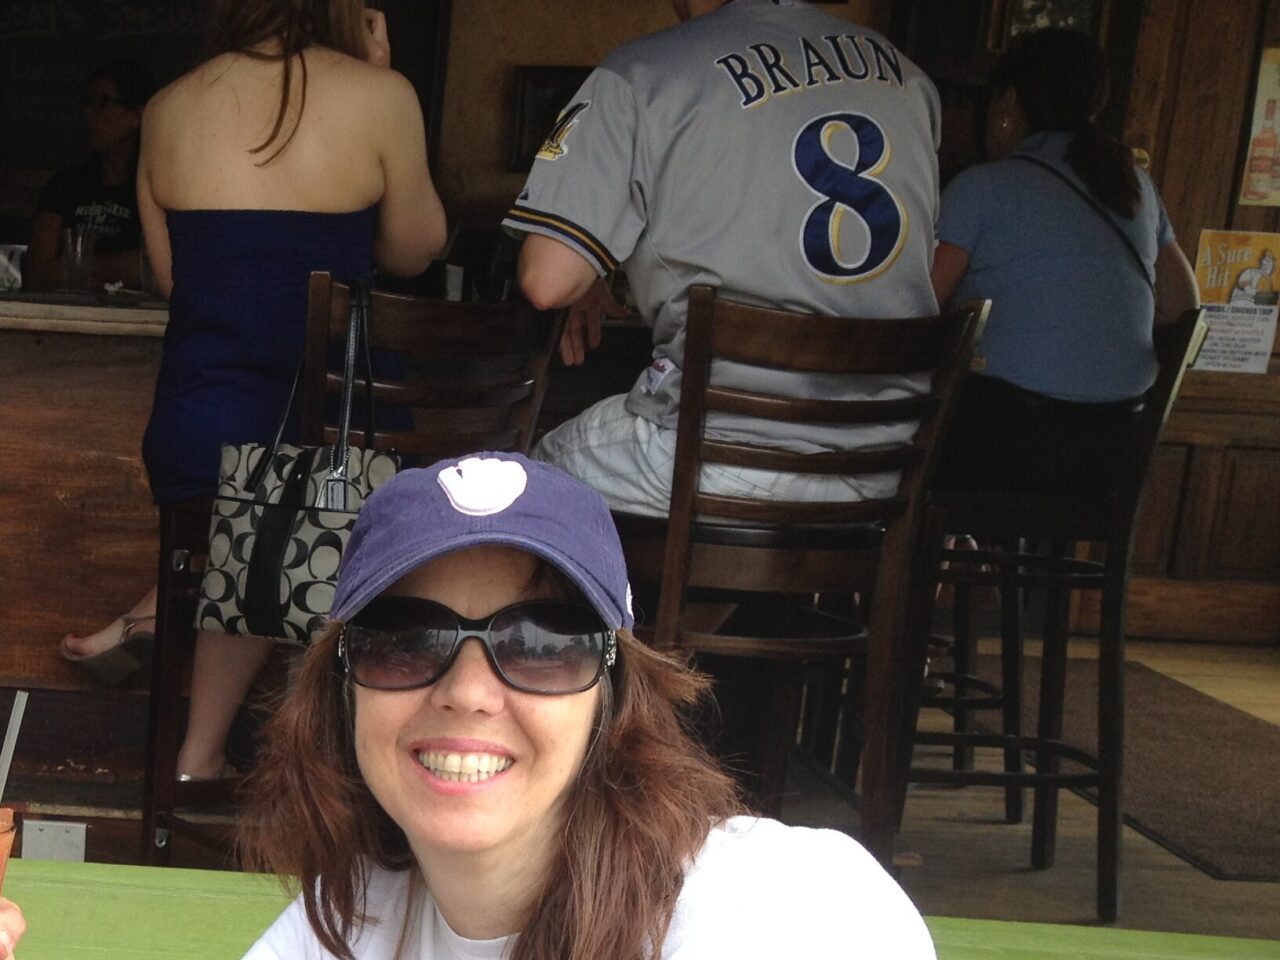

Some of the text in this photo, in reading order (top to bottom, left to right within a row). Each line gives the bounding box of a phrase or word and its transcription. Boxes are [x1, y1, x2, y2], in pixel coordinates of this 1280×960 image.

[715, 34, 906, 108] BRAUN
[791, 110, 910, 285] 8
[1203, 241, 1252, 265] A Sure
[1207, 266, 1231, 288] Hit
